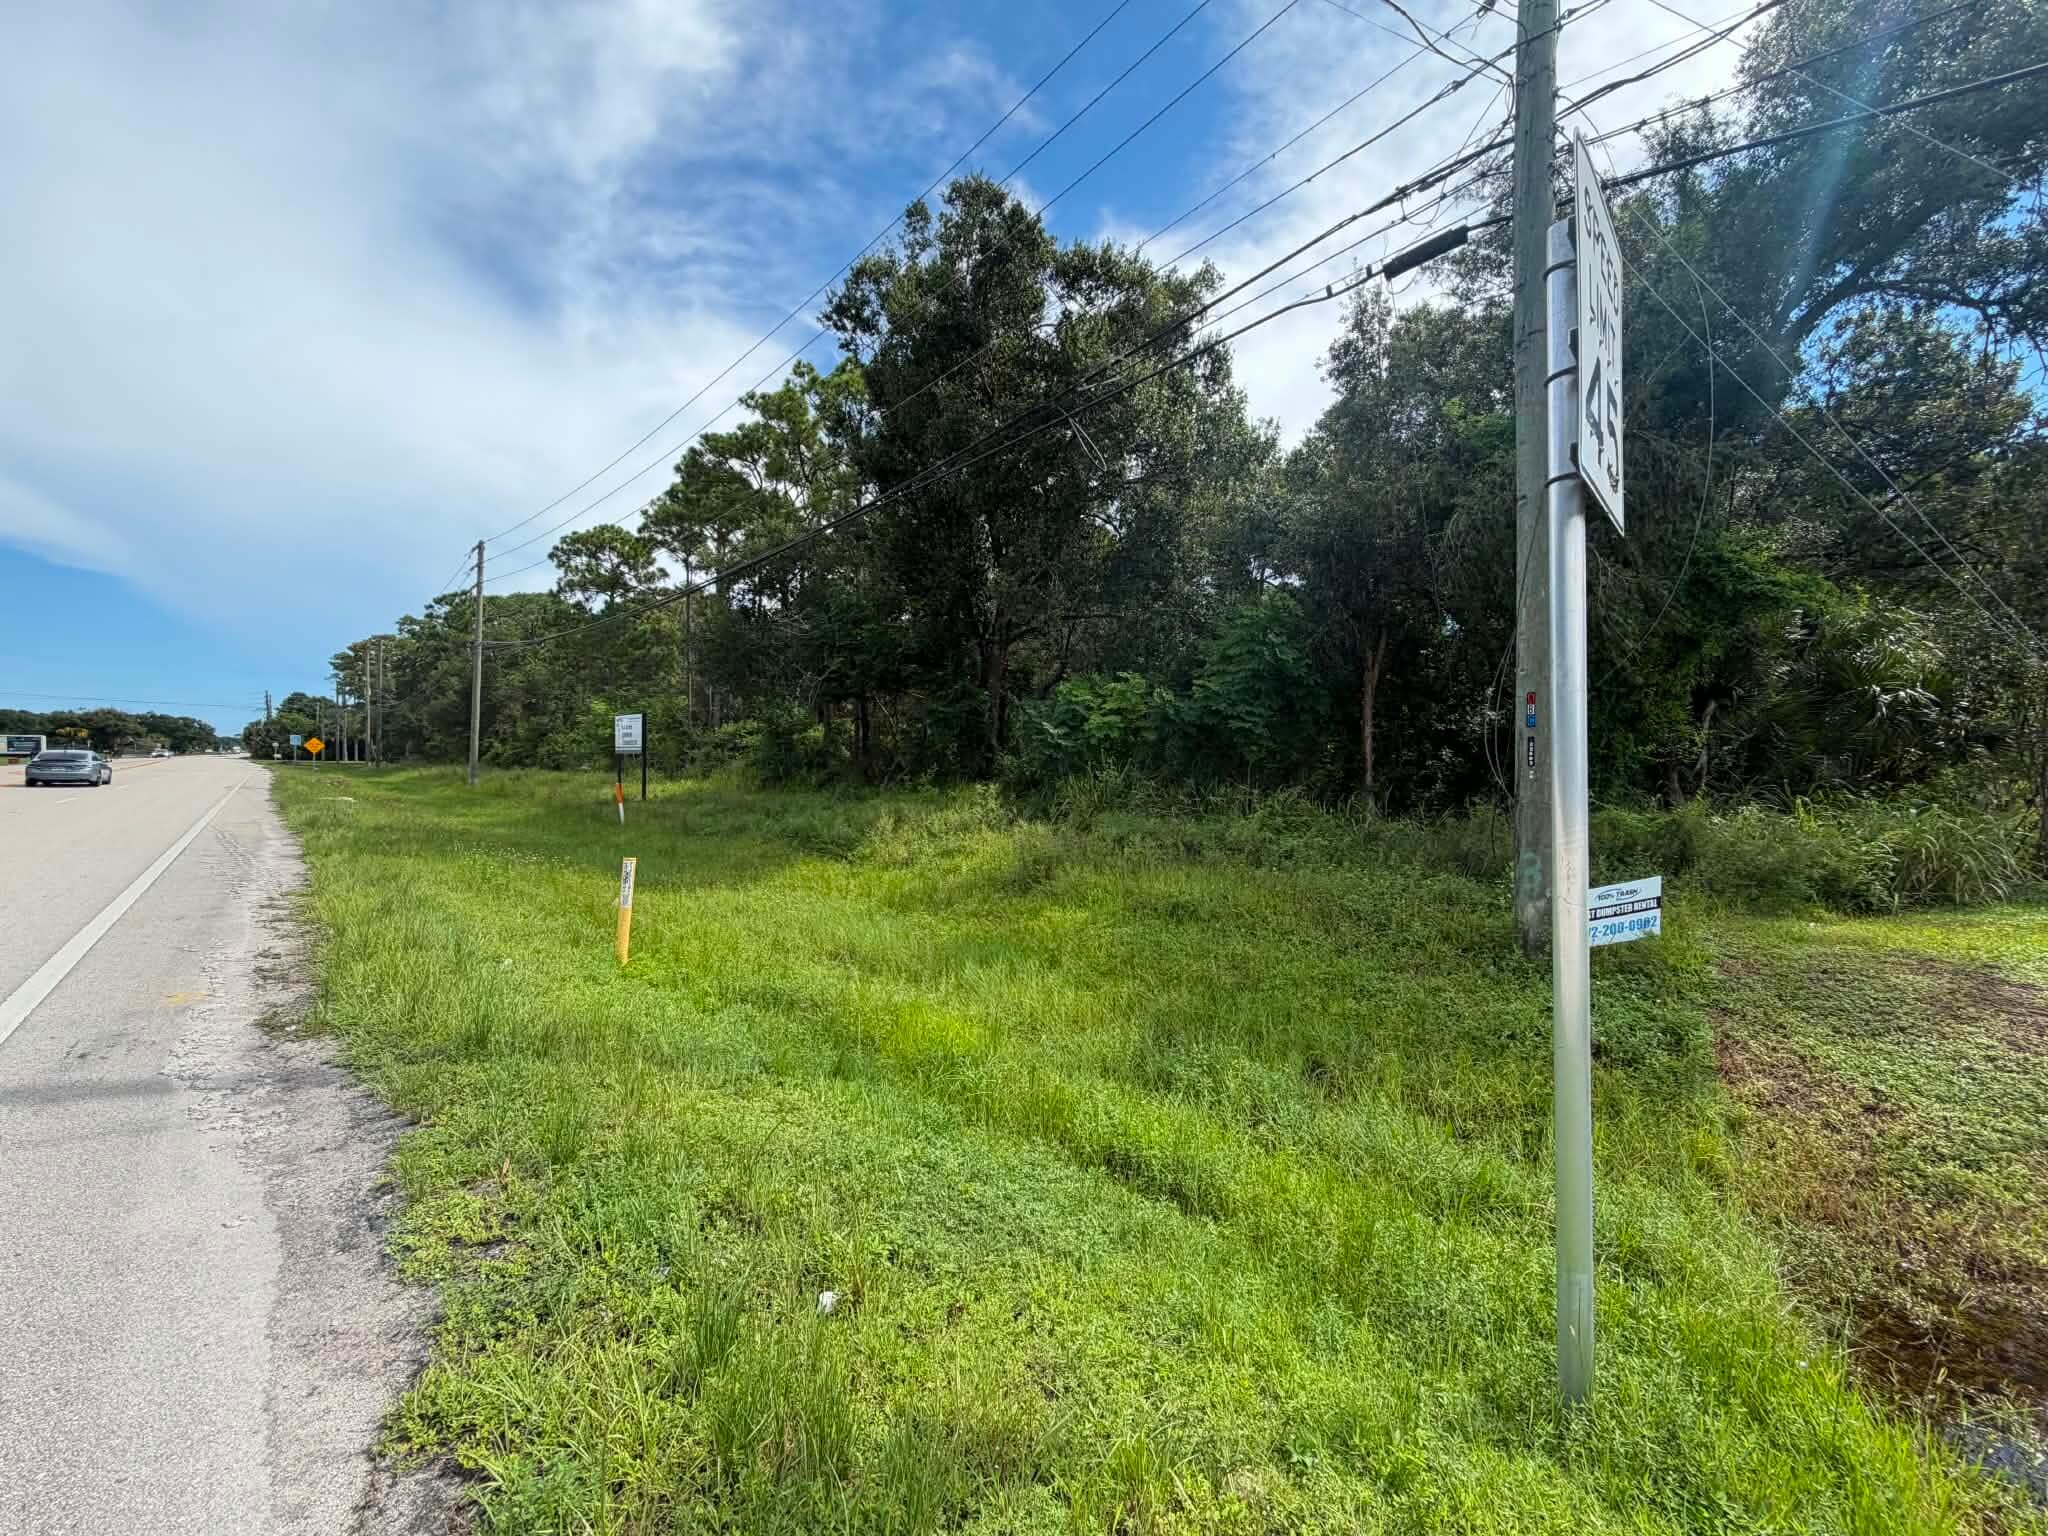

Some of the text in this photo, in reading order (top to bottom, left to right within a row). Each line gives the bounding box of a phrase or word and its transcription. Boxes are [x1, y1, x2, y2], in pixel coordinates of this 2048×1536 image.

[1584, 186, 1619, 317] SPEED
[1588, 263, 1615, 369] LIMIT
[1585, 357, 1619, 493] 45
[1596, 903, 1633, 917] DUMPSTER
[1633, 899, 1657, 910] RENTAL
